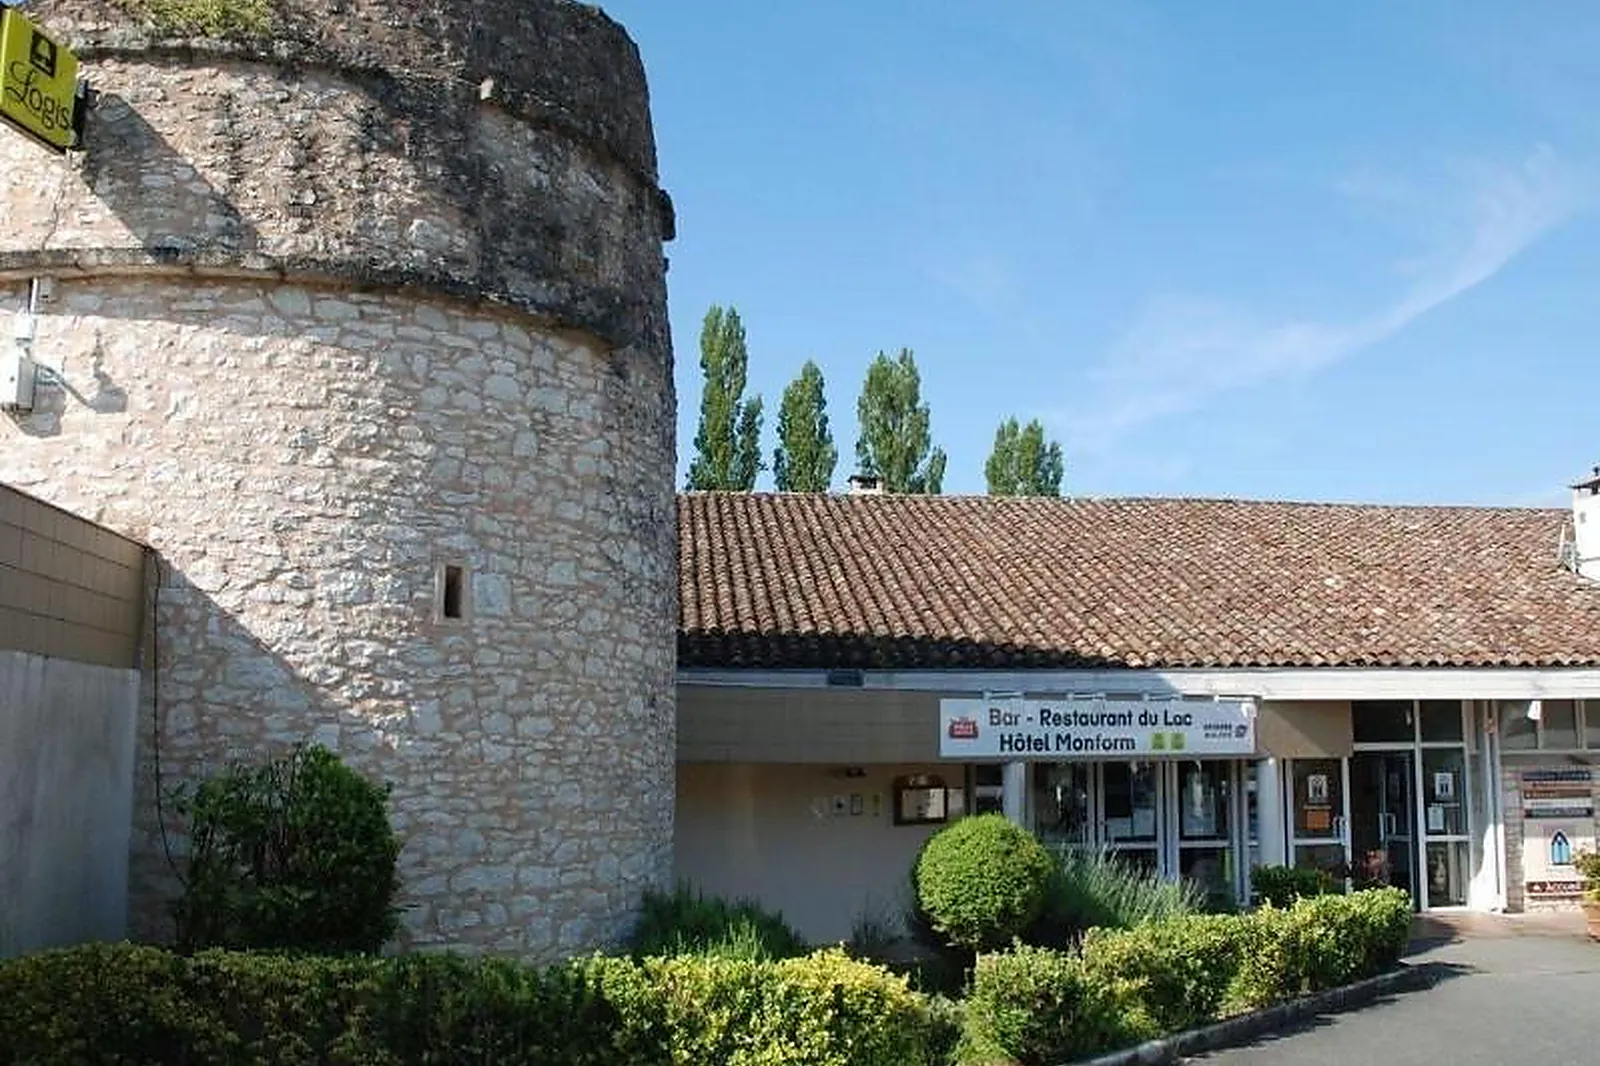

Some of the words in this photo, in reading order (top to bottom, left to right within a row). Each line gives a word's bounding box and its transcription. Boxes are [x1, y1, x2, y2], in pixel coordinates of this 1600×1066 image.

[4, 61, 70, 130] Logis
[989, 708, 1021, 727] Bar
[1040, 708, 1133, 727] Restaurant
[1138, 709, 1158, 726] du
[1164, 709, 1193, 726] Lac
[1000, 732, 1050, 752] Hôtel
[1055, 732, 1136, 752] Monform
